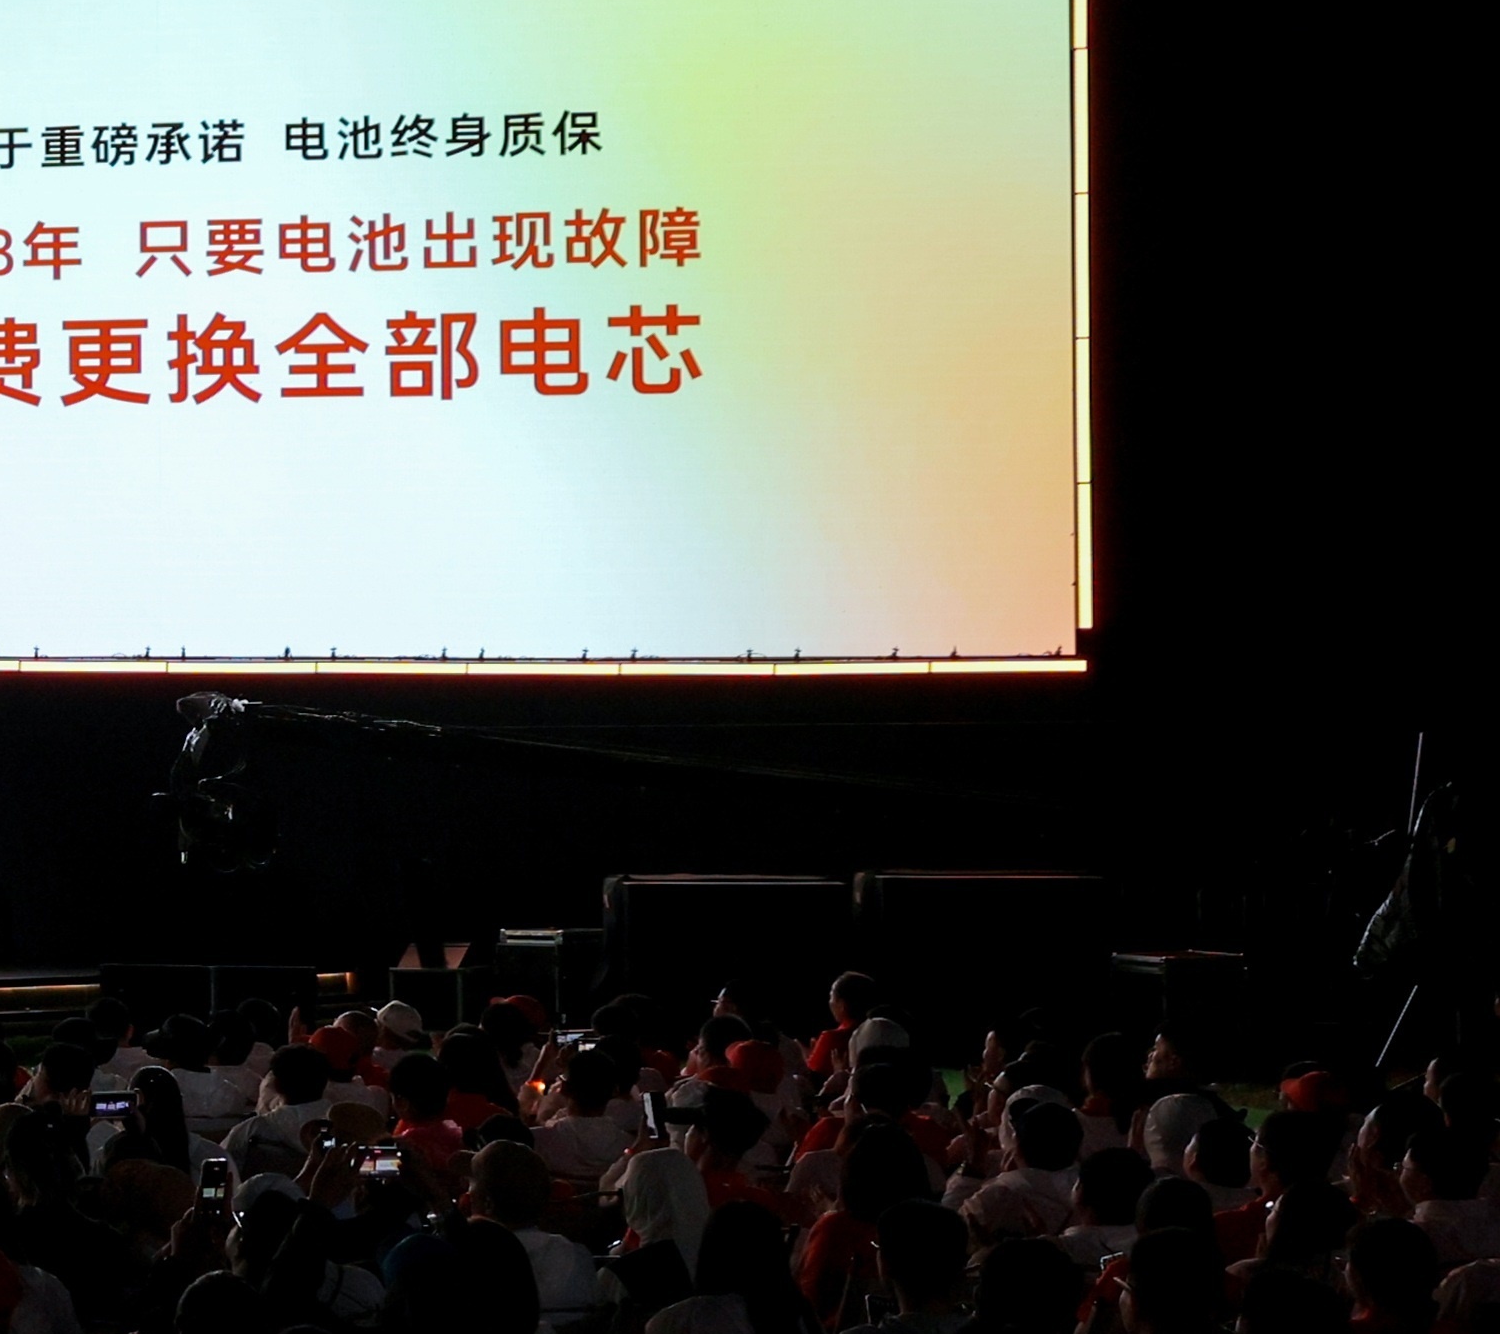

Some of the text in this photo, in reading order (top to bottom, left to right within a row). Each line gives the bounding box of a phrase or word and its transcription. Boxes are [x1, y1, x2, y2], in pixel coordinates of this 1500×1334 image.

[285, 110, 602, 160] 电池终身质保
[137, 208, 700, 276] 只要电池出现故障
